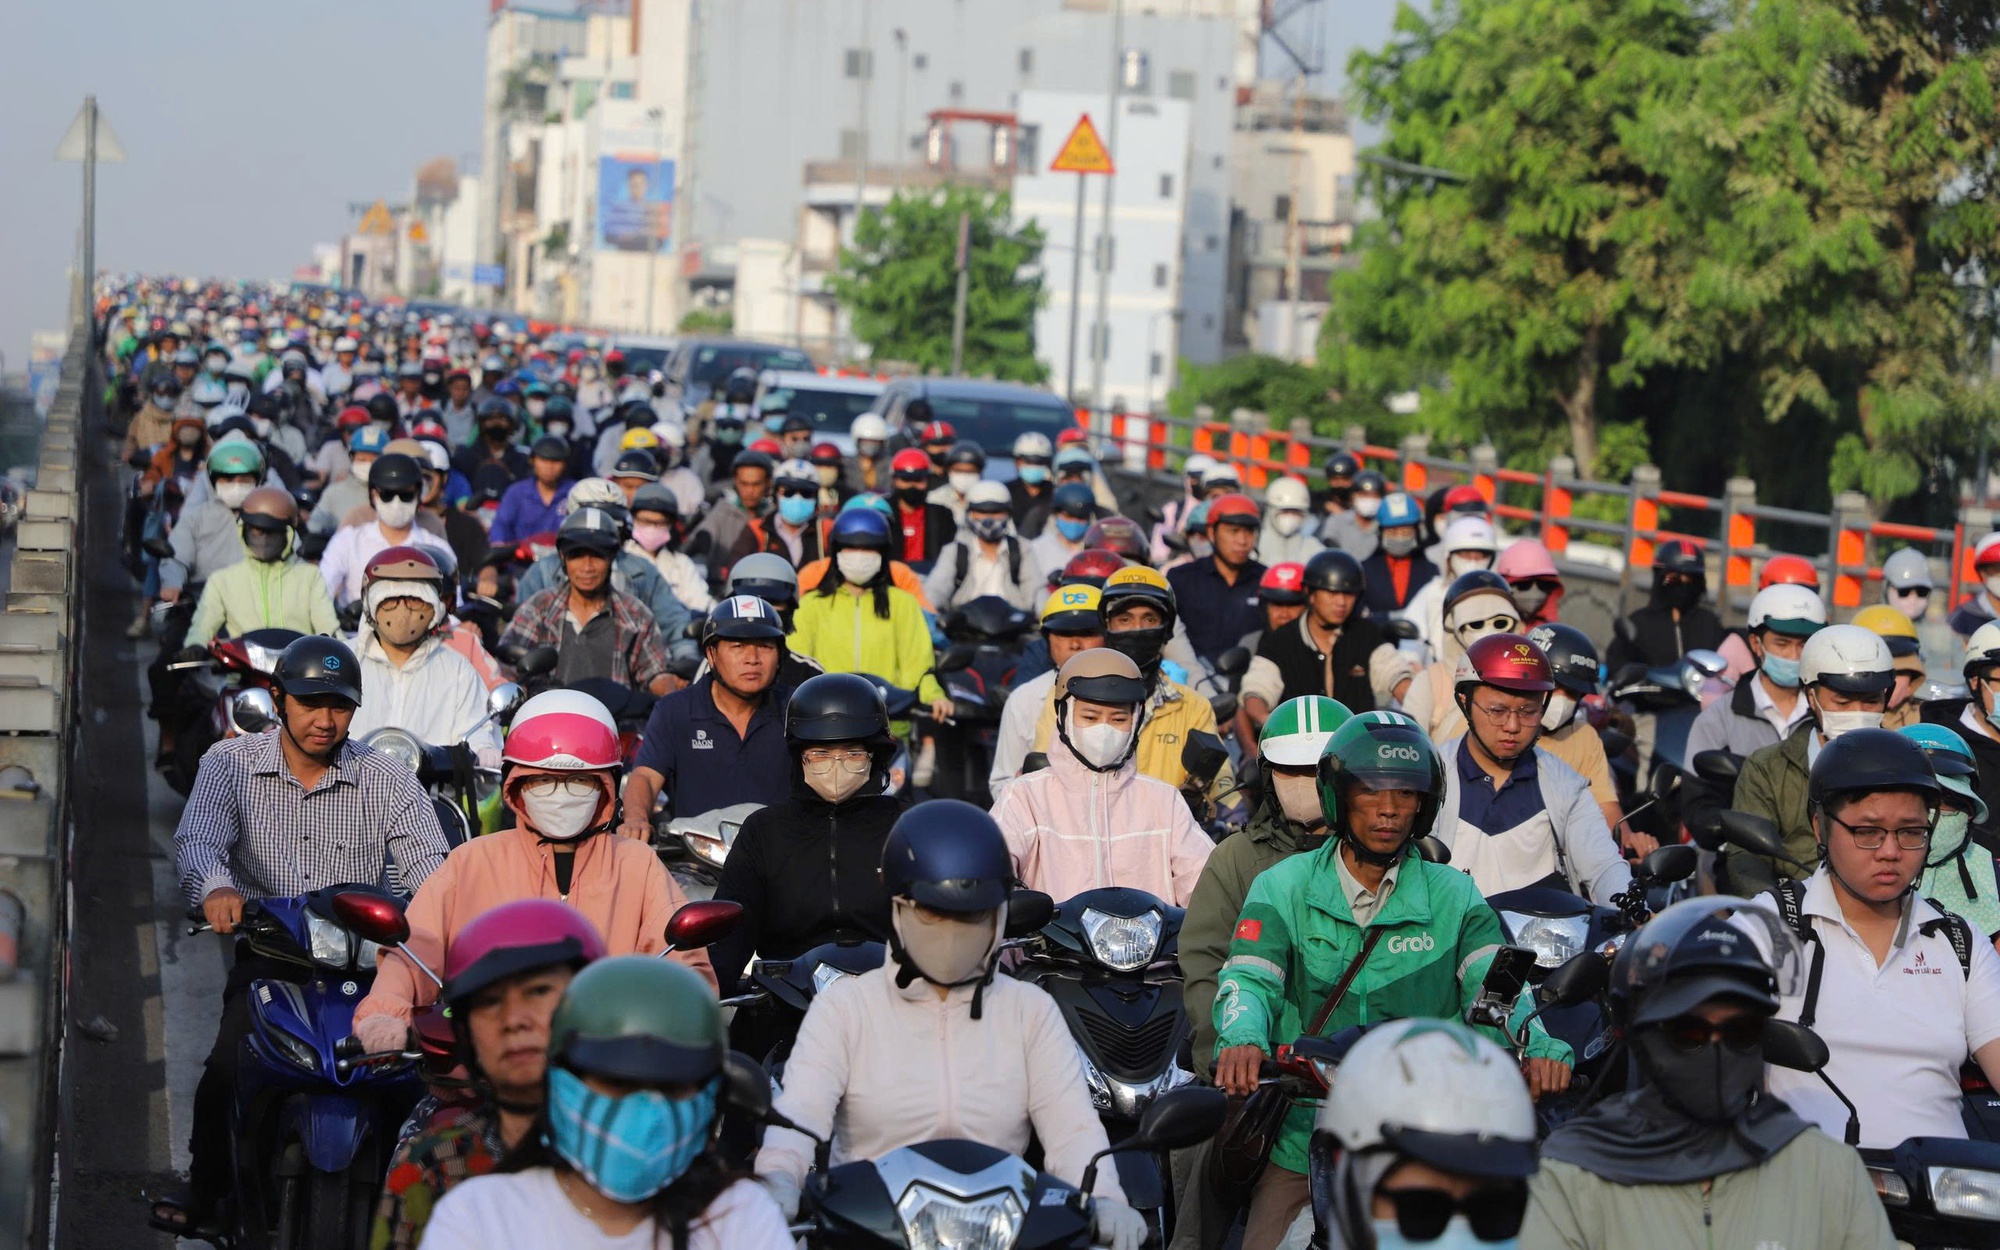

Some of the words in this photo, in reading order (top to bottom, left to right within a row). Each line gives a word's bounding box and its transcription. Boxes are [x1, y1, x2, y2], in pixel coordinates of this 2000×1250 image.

[1062, 592, 1089, 605] be
[691, 739, 714, 747] DAON
[1378, 744, 1420, 761] Grab
[540, 758, 585, 768] Andes
[1387, 931, 1435, 955] Grab
